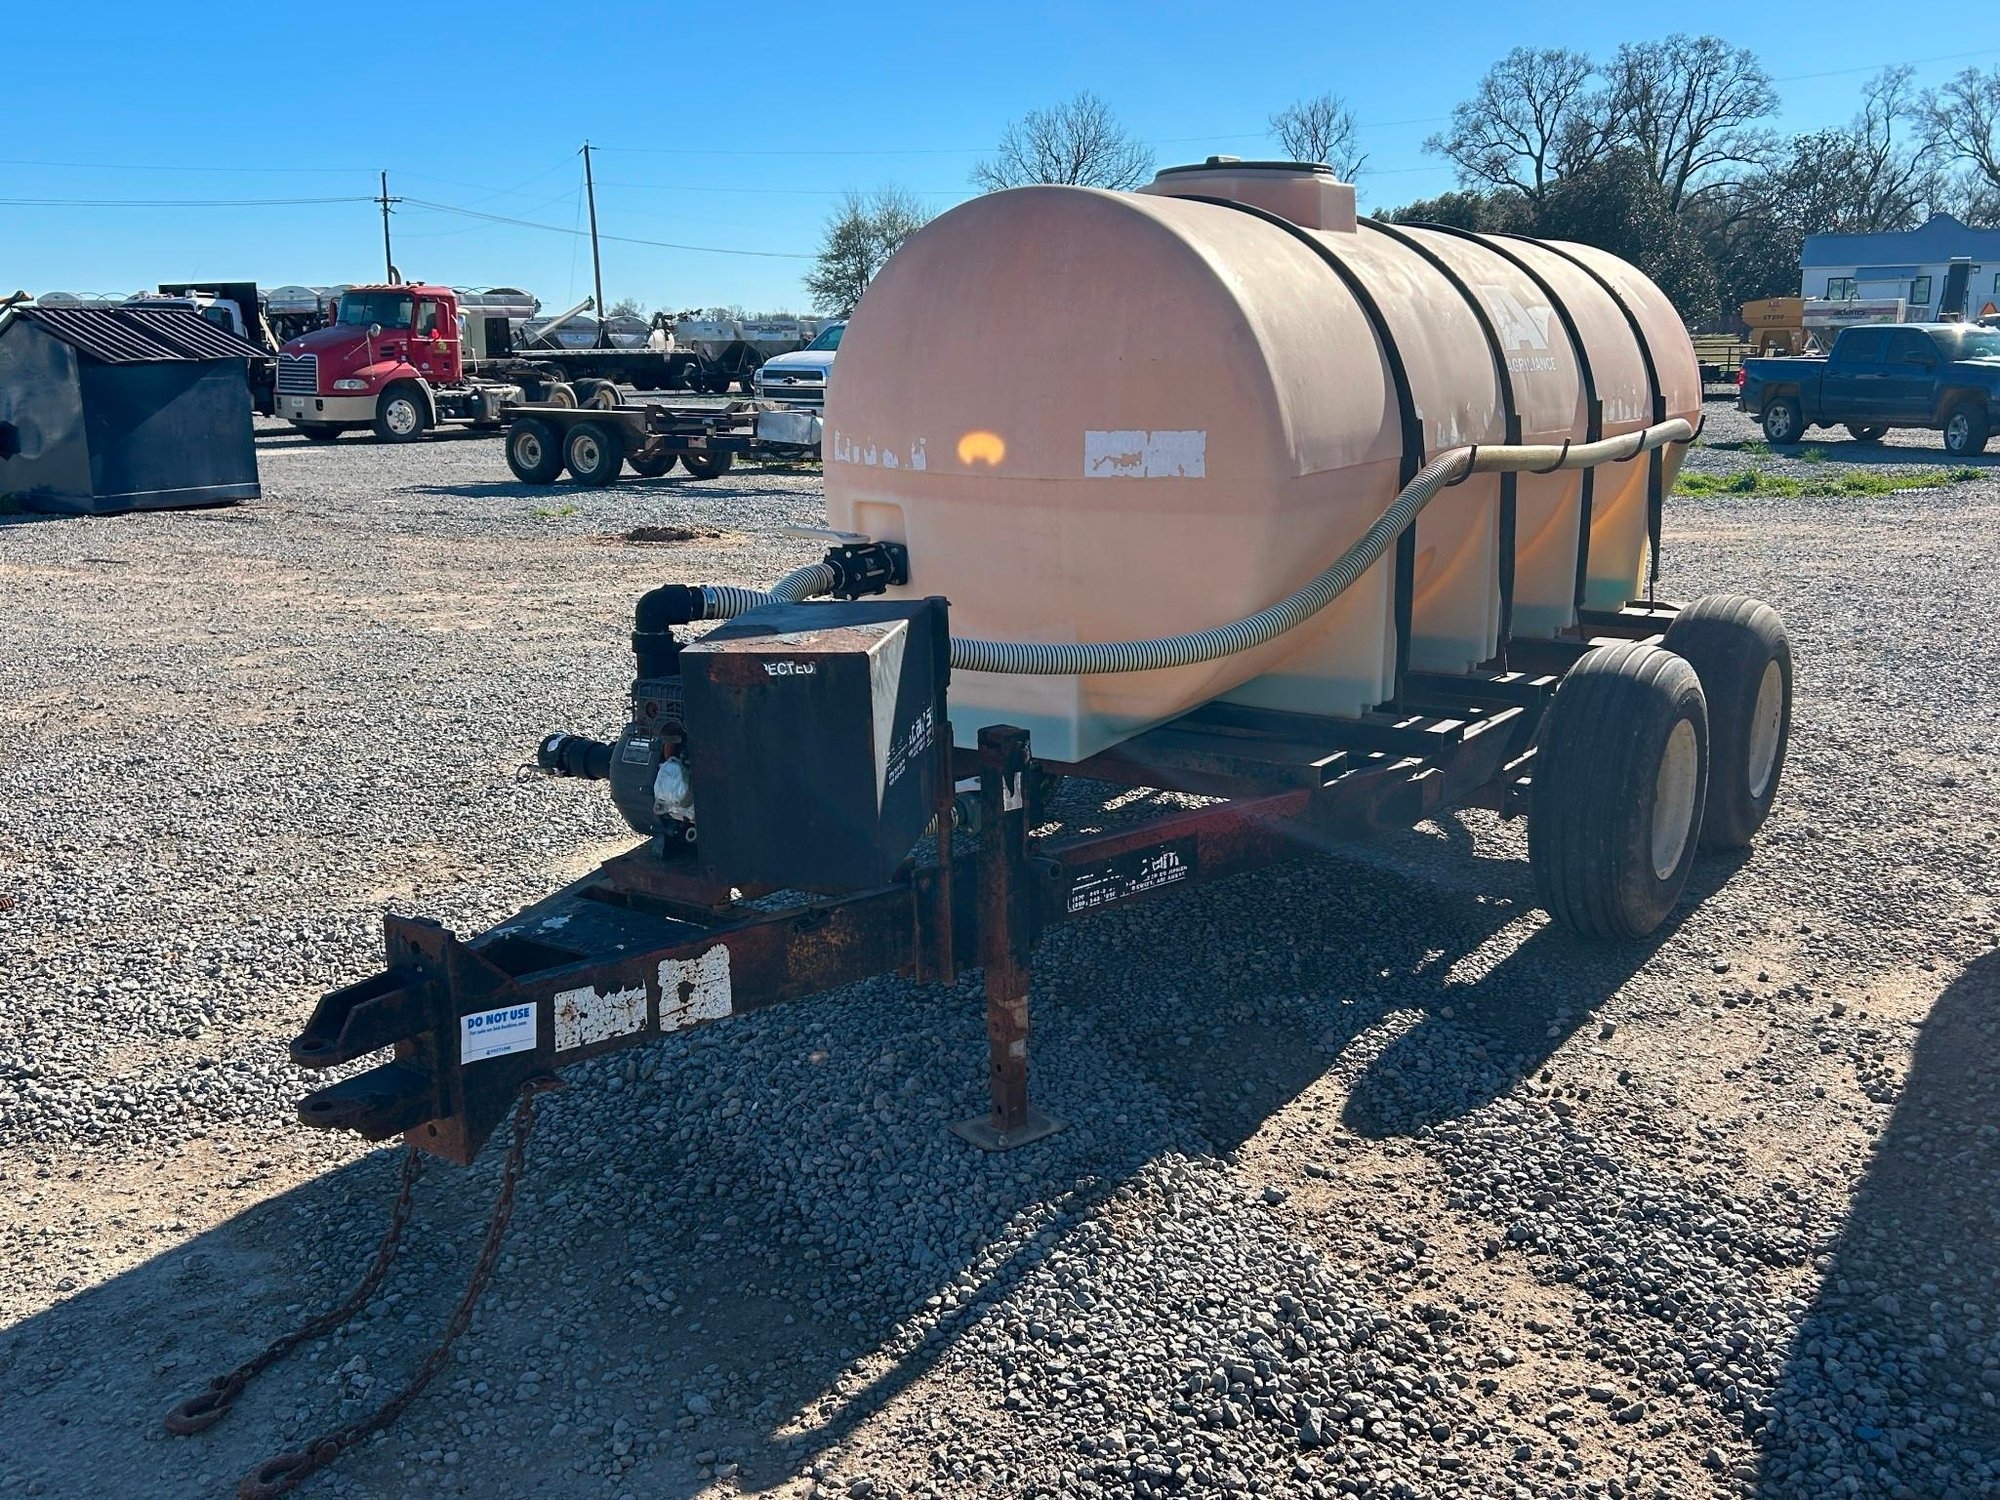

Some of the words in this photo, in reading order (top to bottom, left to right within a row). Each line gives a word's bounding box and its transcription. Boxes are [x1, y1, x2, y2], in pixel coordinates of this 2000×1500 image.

[467, 1016, 483, 1029] DO
[486, 1011, 508, 1025] NOT
[510, 1007, 530, 1020] USE
